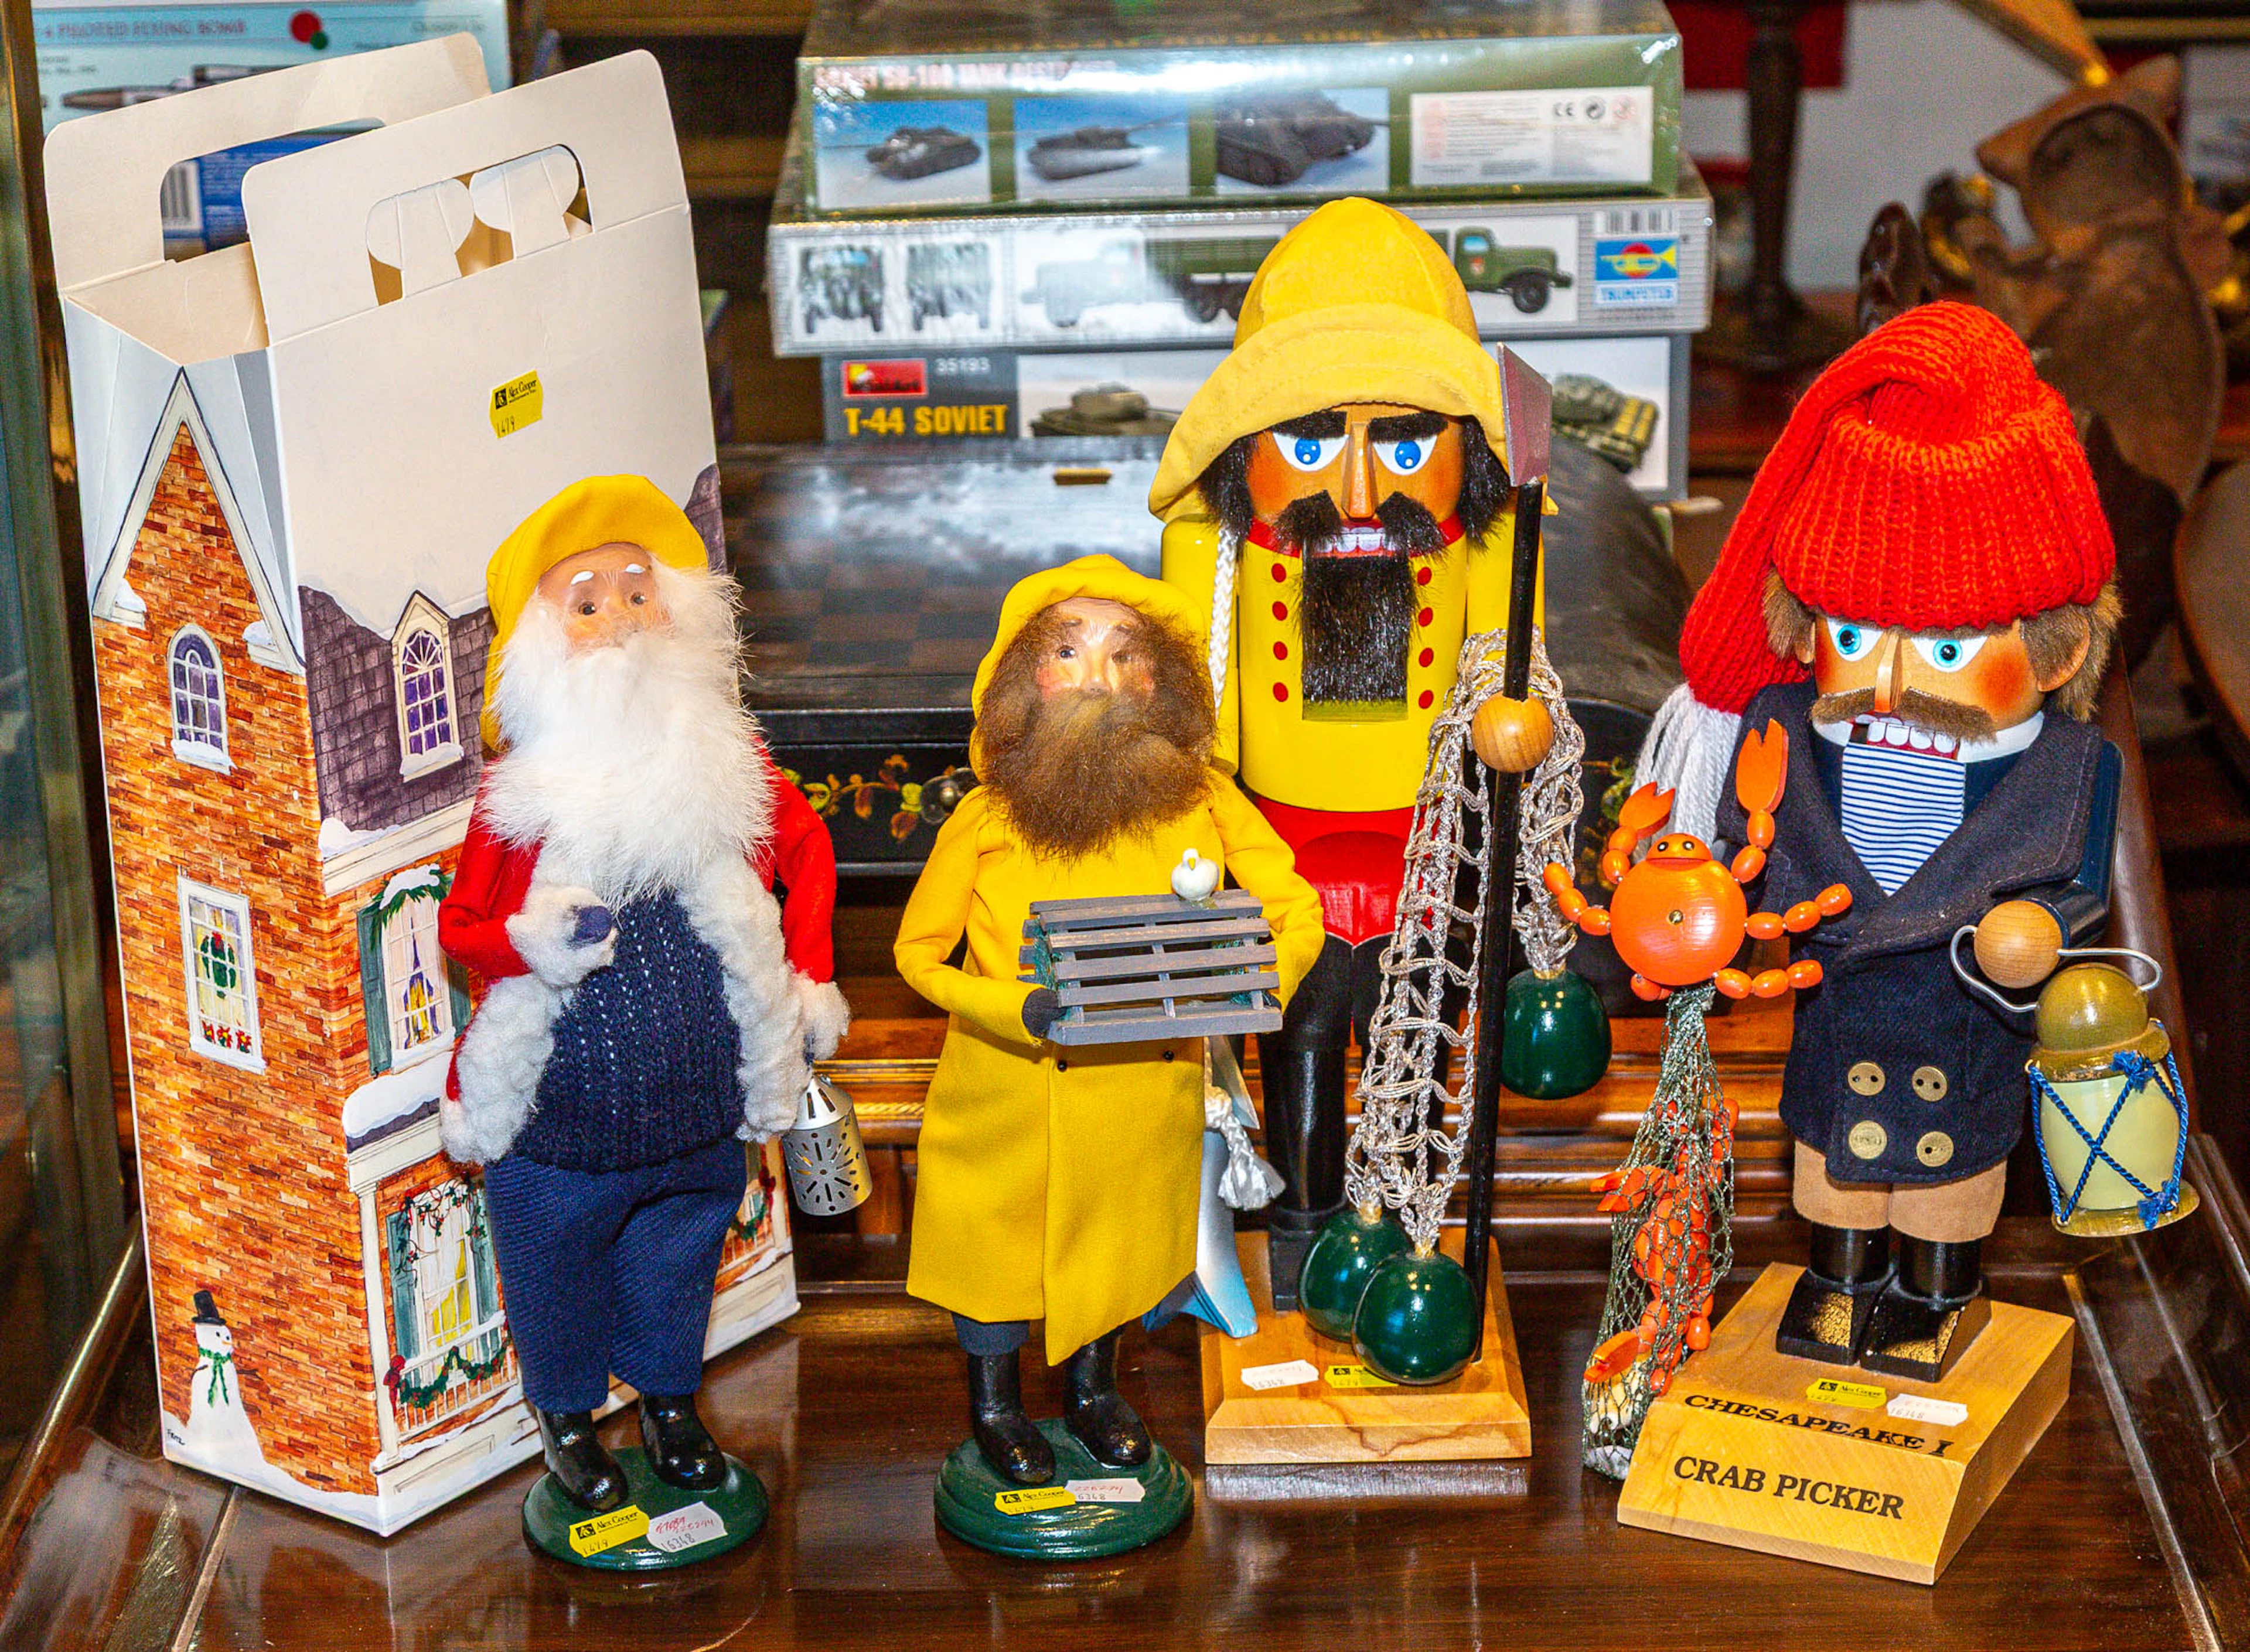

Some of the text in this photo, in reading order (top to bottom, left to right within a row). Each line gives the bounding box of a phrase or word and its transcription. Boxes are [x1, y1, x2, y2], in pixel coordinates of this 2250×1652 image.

[936, 357, 991, 376] 35193
[844, 404, 1008, 436] T-44 SOVIET
[1685, 1394, 1954, 1458] CHESAPEAKE I
[1674, 1456, 1904, 1519] CRAB PICKER
[596, 1520, 612, 1530] Alex
[612, 1511, 637, 1523] Cooper
[660, 1532, 696, 1551] 16348
